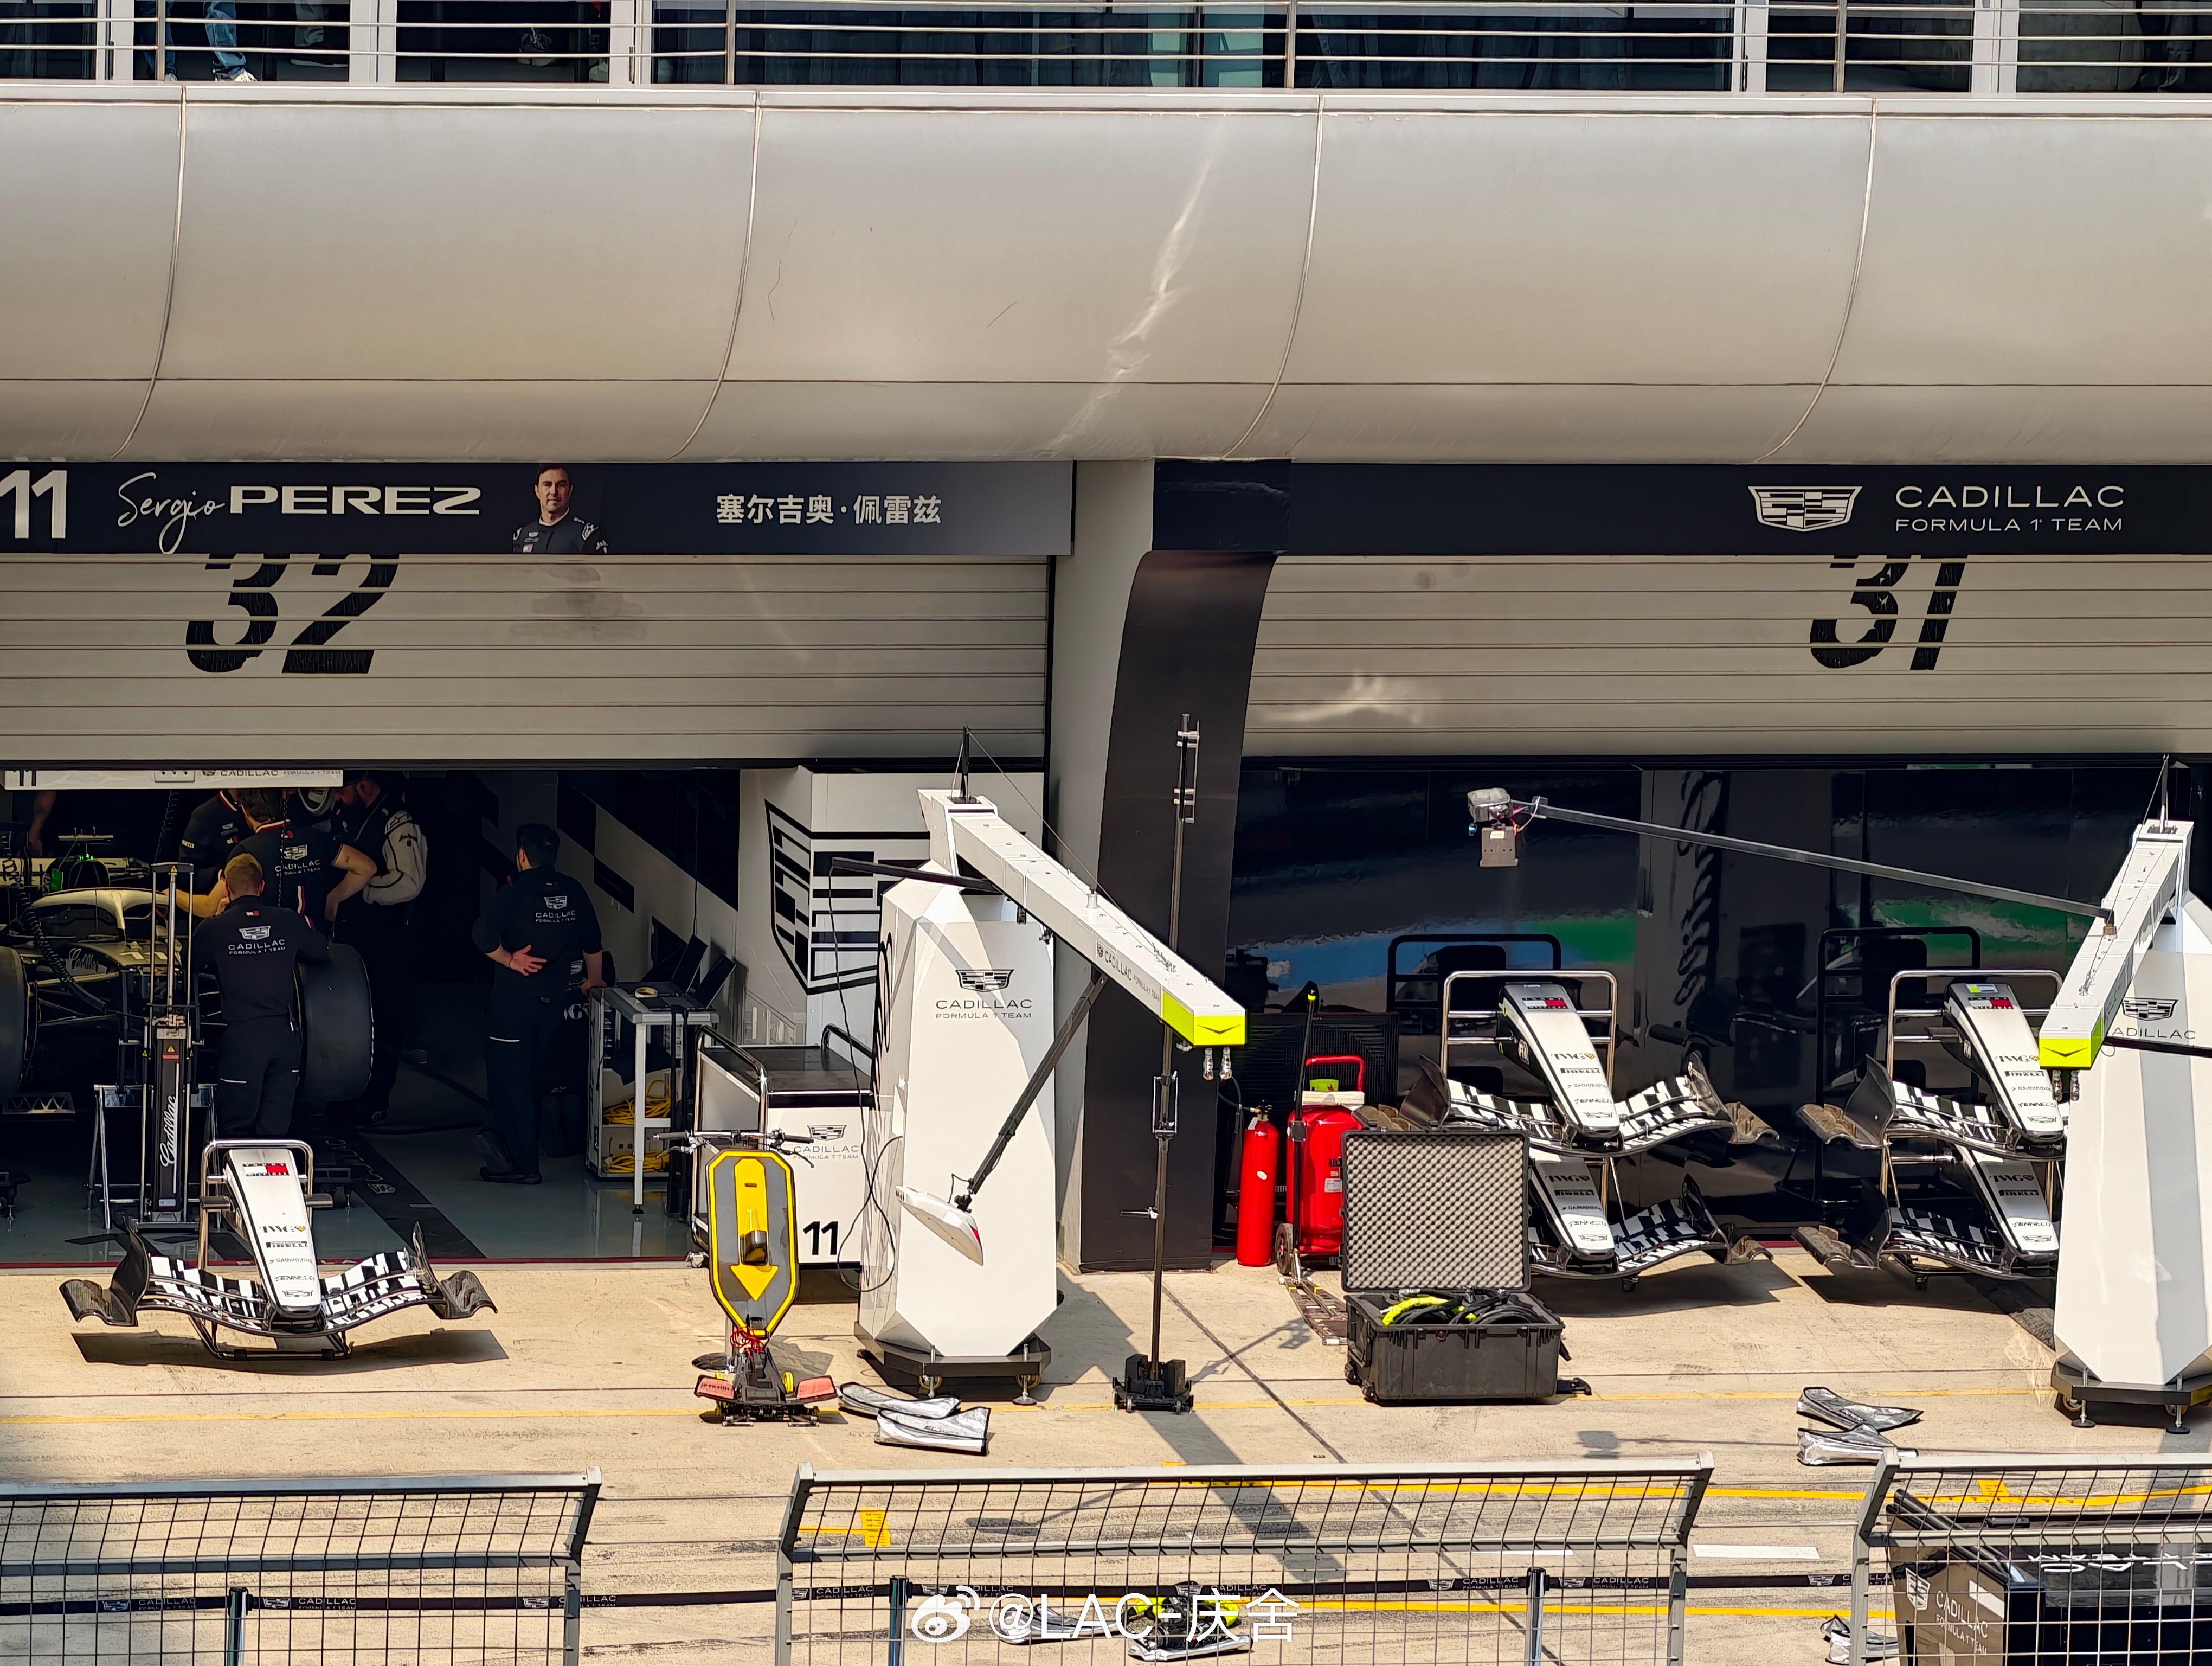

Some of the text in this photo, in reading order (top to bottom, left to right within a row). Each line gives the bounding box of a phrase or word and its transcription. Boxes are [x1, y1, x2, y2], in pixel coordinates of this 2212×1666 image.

[0, 470, 67, 539] 11
[716, 494, 942, 525] 塞尔吉奥·佩雷兹
[1895, 486, 2125, 508] CADILLAC
[118, 472, 481, 554] Sergio PEREZ
[1896, 518, 2021, 532] FORMULA
[2052, 518, 2123, 532] TEAM
[186, 553, 400, 674] 32
[1810, 554, 1969, 670] 31
[228, 939, 285, 950] CADILLAC
[1104, 950, 1132, 981] CADILLAC
[936, 999, 1032, 1009] CADILLAC
[2107, 1027, 2196, 1040] ADILLAC
[803, 1221, 839, 1255] 11
[816, 1586, 873, 1594] CADLLAC
[1936, 1590, 1988, 1638] CADILLAC
